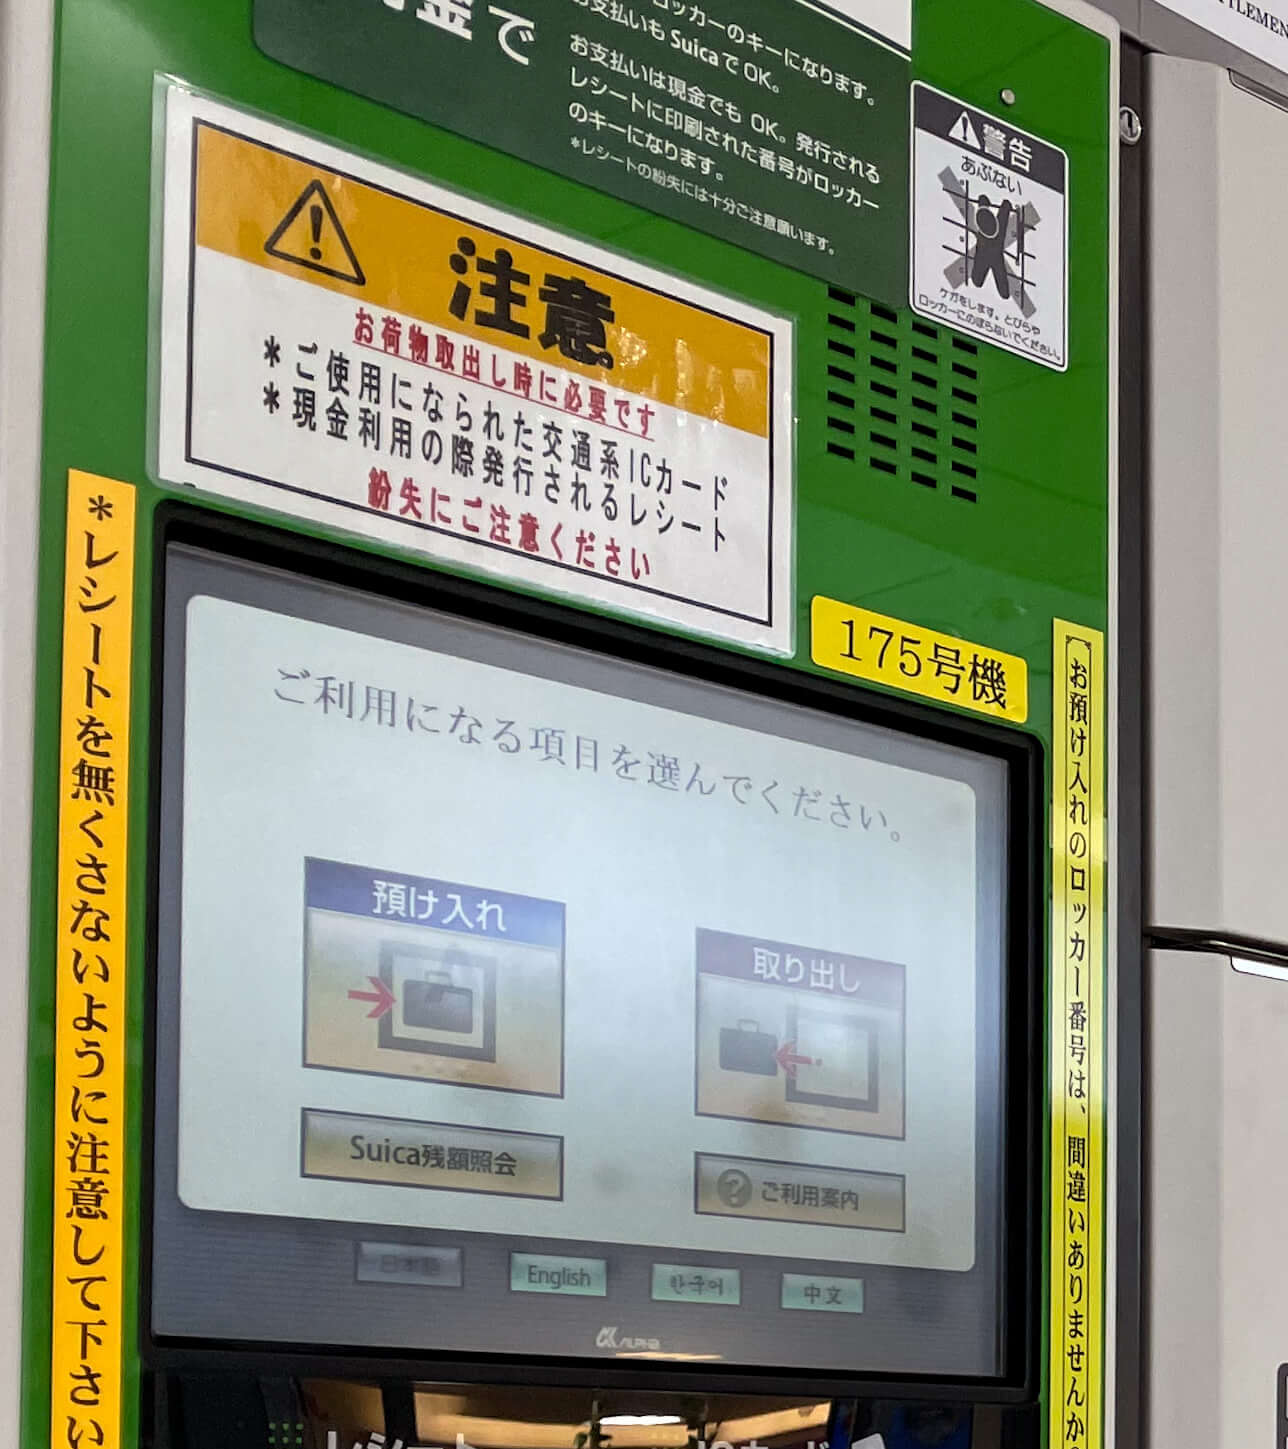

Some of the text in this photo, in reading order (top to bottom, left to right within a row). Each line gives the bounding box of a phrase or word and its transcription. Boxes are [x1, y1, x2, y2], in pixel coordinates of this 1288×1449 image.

[569, 102, 724, 181] のキーになります。
[571, 67, 879, 210] レシートに印刷された番号がロッカー
[982, 123, 1032, 172] 警告
[961, 155, 1022, 195] あぶない
[448, 235, 616, 372] 注意
[353, 306, 657, 437] お荷物取出し時に必要です
[367, 466, 650, 580] 紛失にご注意ください
[837, 617, 1010, 712] 175号機
[270, 664, 905, 844] ご利用になる項目を選んでください。
[370, 876, 508, 935] 預け入れ
[751, 944, 863, 995] 取り出し
[760, 1176, 860, 1213] ご利用案内
[527, 1264, 591, 1289] English
[804, 1284, 842, 1306] 中文
